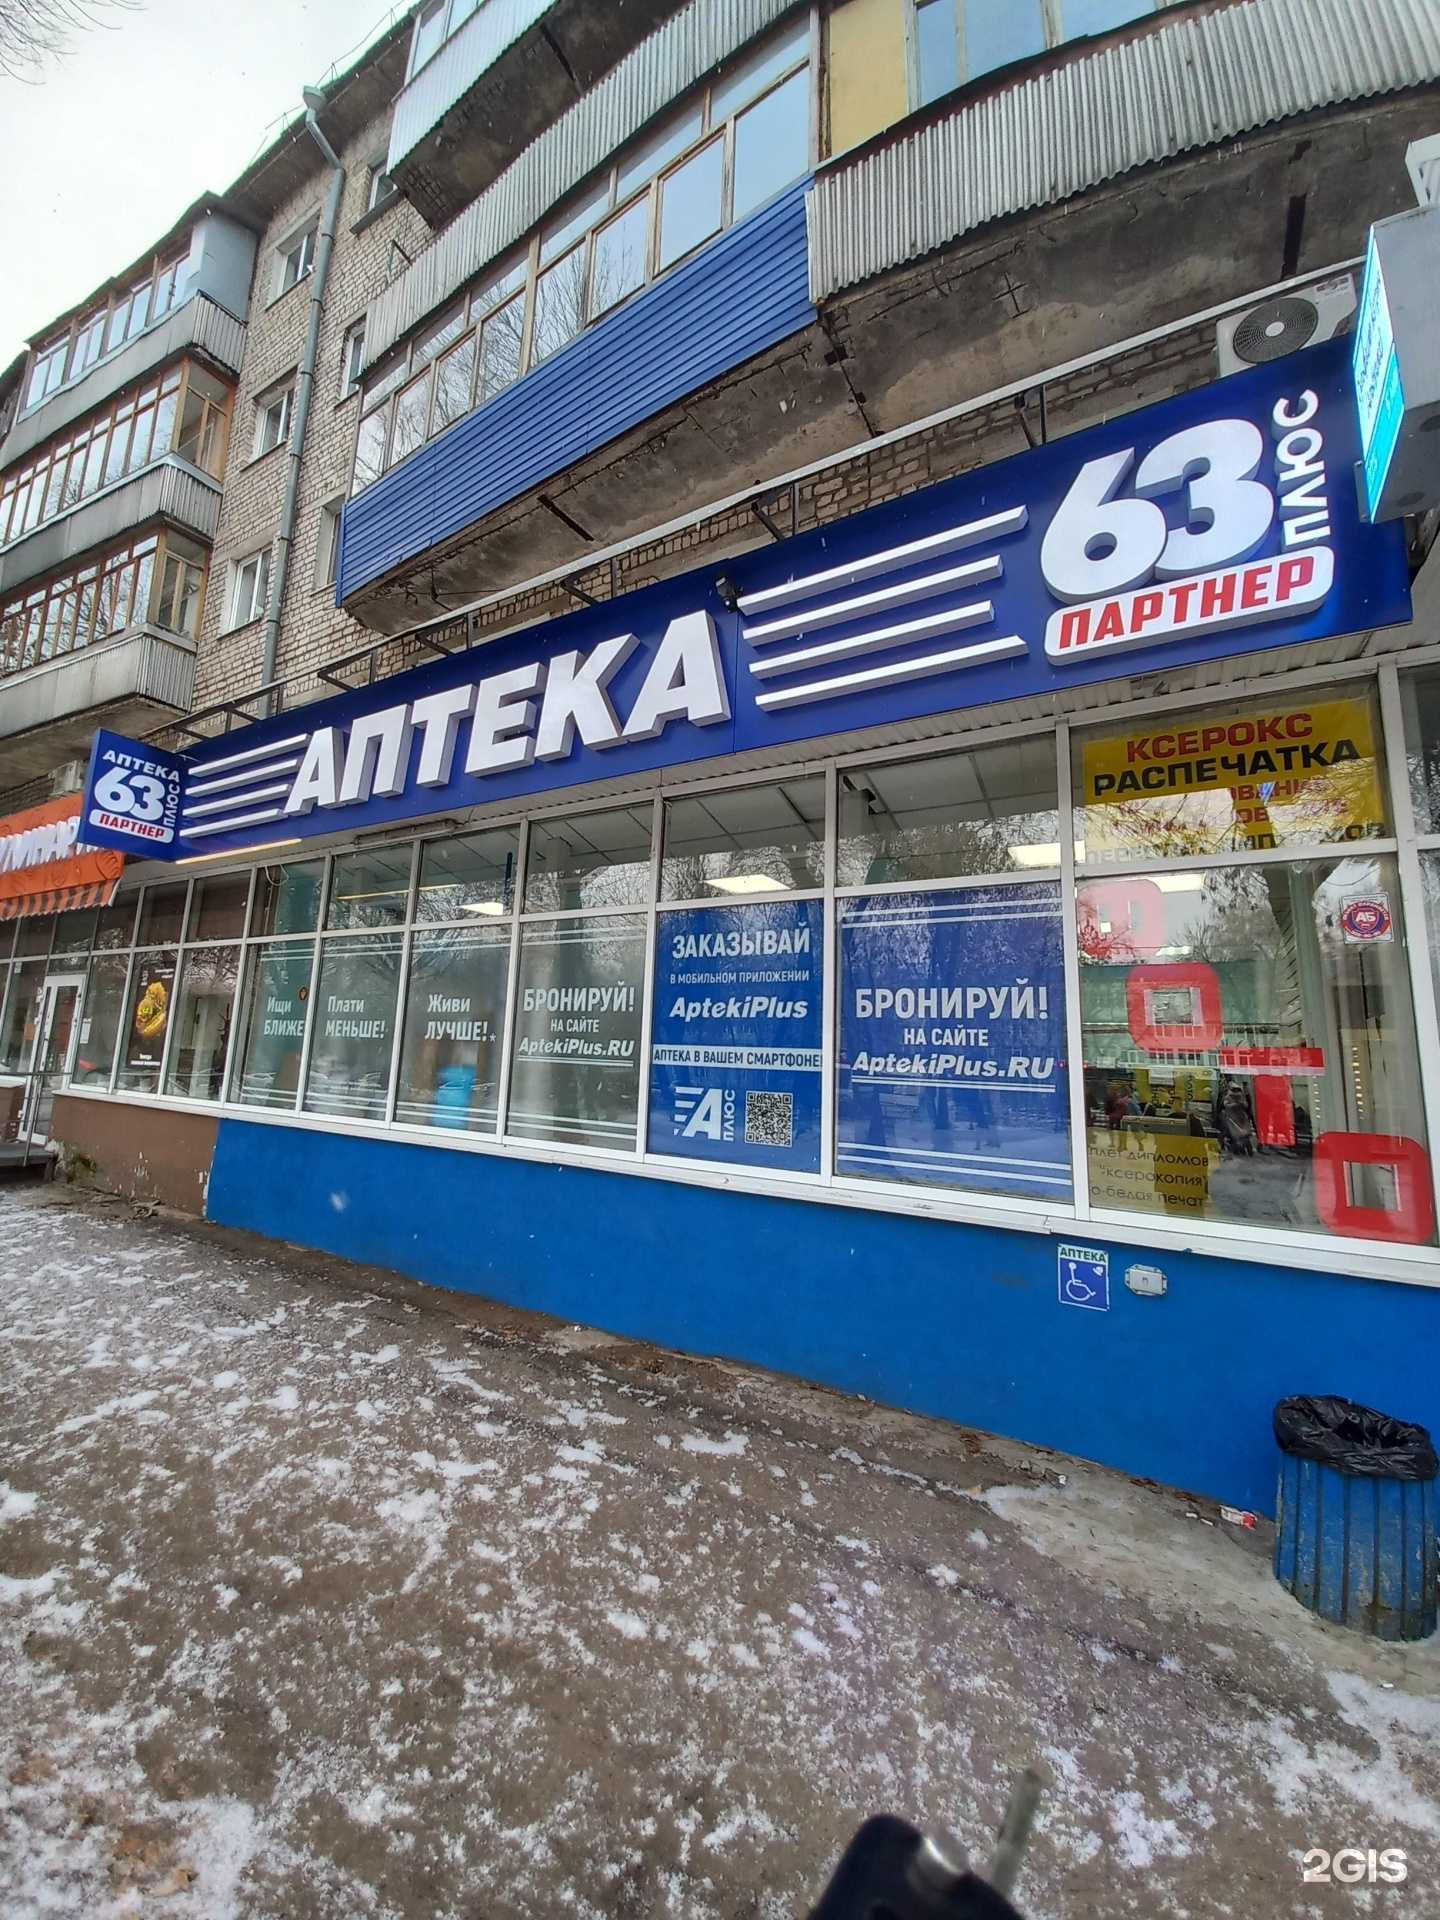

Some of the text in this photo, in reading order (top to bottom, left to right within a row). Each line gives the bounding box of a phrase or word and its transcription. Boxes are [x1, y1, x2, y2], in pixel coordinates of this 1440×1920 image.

[1272, 389, 1331, 552] ПЛЮС
[1040, 418, 1275, 605] 63
[1058, 555, 1314, 649] ПАРТНЕР
[283, 609, 731, 816] АПТЕКА
[1127, 713, 1314, 764] КСЕРОКС
[102, 749, 180, 783] АПТЕКА
[1094, 738, 1362, 797] РАСПЕЧАТКА
[94, 766, 166, 821] 63
[162, 783, 181, 828] ПЛЮС
[99, 813, 166, 839] ПАРТНЕР
[671, 921, 811, 960] ЗАКАЗЫВАЙ
[670, 970, 810, 985] В МОБИЛЬНОМ ПРИЛОЖЕНИИ
[267, 997, 292, 1013] Ищи
[327, 997, 364, 1014] Плати
[427, 995, 471, 1013] Живи
[523, 981, 635, 1013] БРОНИРУЙ!
[669, 995, 809, 1023] AptekiPlus
[855, 977, 1049, 1020] БРОНИРУЙ!
[325, 1020, 386, 1039] МЕНЬШЕ!
[551, 1016, 600, 1033] НА САЙТЕ
[904, 1025, 989, 1047] НА САЙТЕ
[519, 1036, 635, 1057] AptekiPlus.RU
[654, 1049, 691, 1063] АПТЕКА
[694, 1051, 700, 1063] В
[703, 1051, 744, 1065] ВАШЕМ
[851, 1051, 1055, 1079] AptekiPlus.RU
[722, 1088, 736, 1142] ПЛЮС
[1060, 1247, 1107, 1264] АПТЕКА
